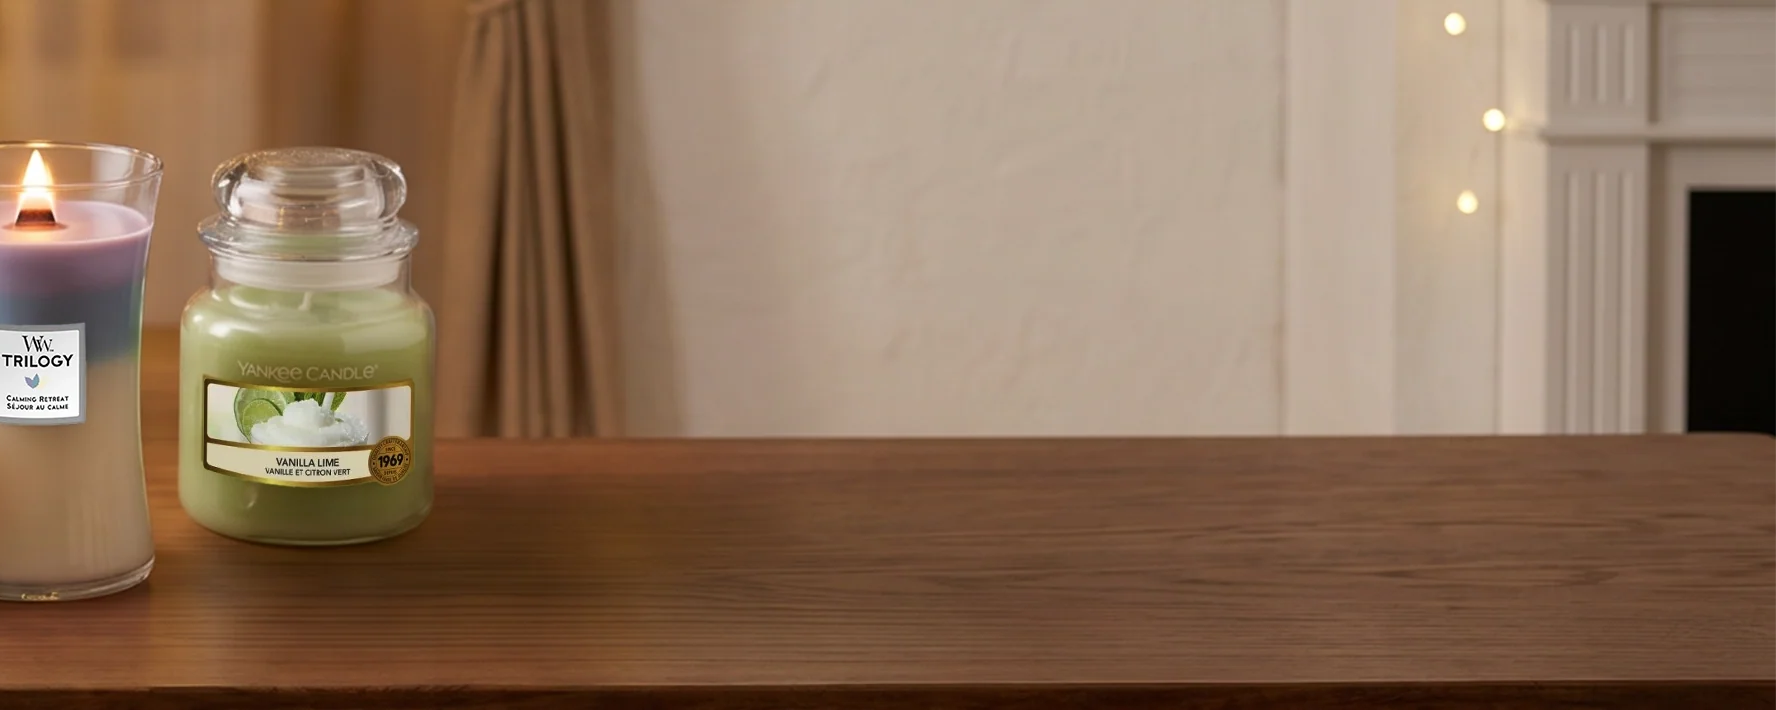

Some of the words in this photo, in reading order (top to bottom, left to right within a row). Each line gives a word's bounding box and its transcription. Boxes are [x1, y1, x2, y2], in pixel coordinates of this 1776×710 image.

[1, 354, 74, 368] TRILOGY
[275, 457, 315, 467] VANILLA
[317, 458, 340, 467] LIME
[377, 453, 404, 468] 1969
